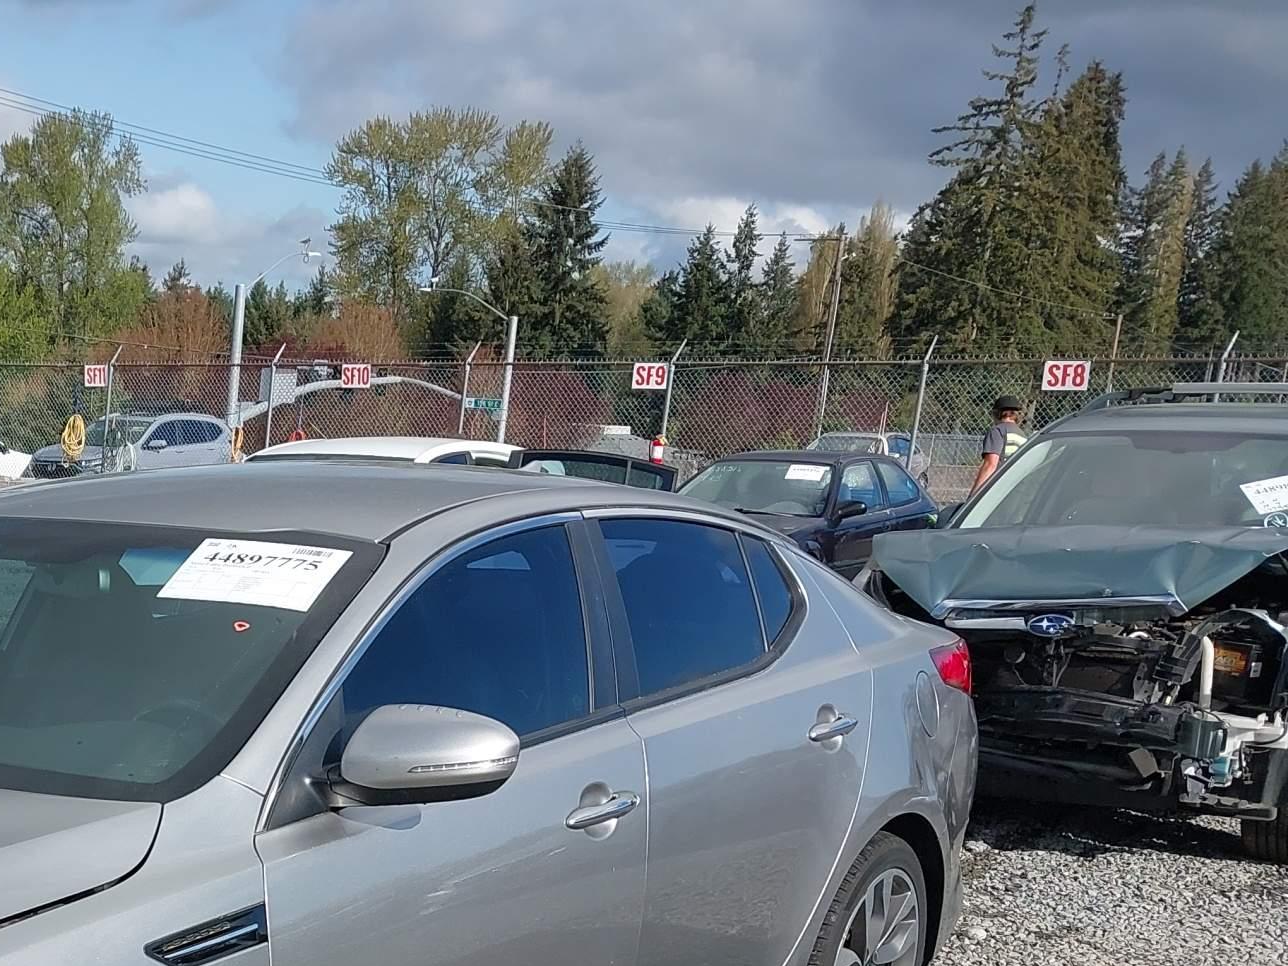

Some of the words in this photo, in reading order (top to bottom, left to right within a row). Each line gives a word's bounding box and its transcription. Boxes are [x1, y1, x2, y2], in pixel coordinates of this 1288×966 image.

[87, 367, 106, 384] SF11
[343, 367, 369, 385] SF10
[635, 366, 665, 385] SF9
[1047, 364, 1086, 387] SF8
[204, 551, 323, 571] 44897775
